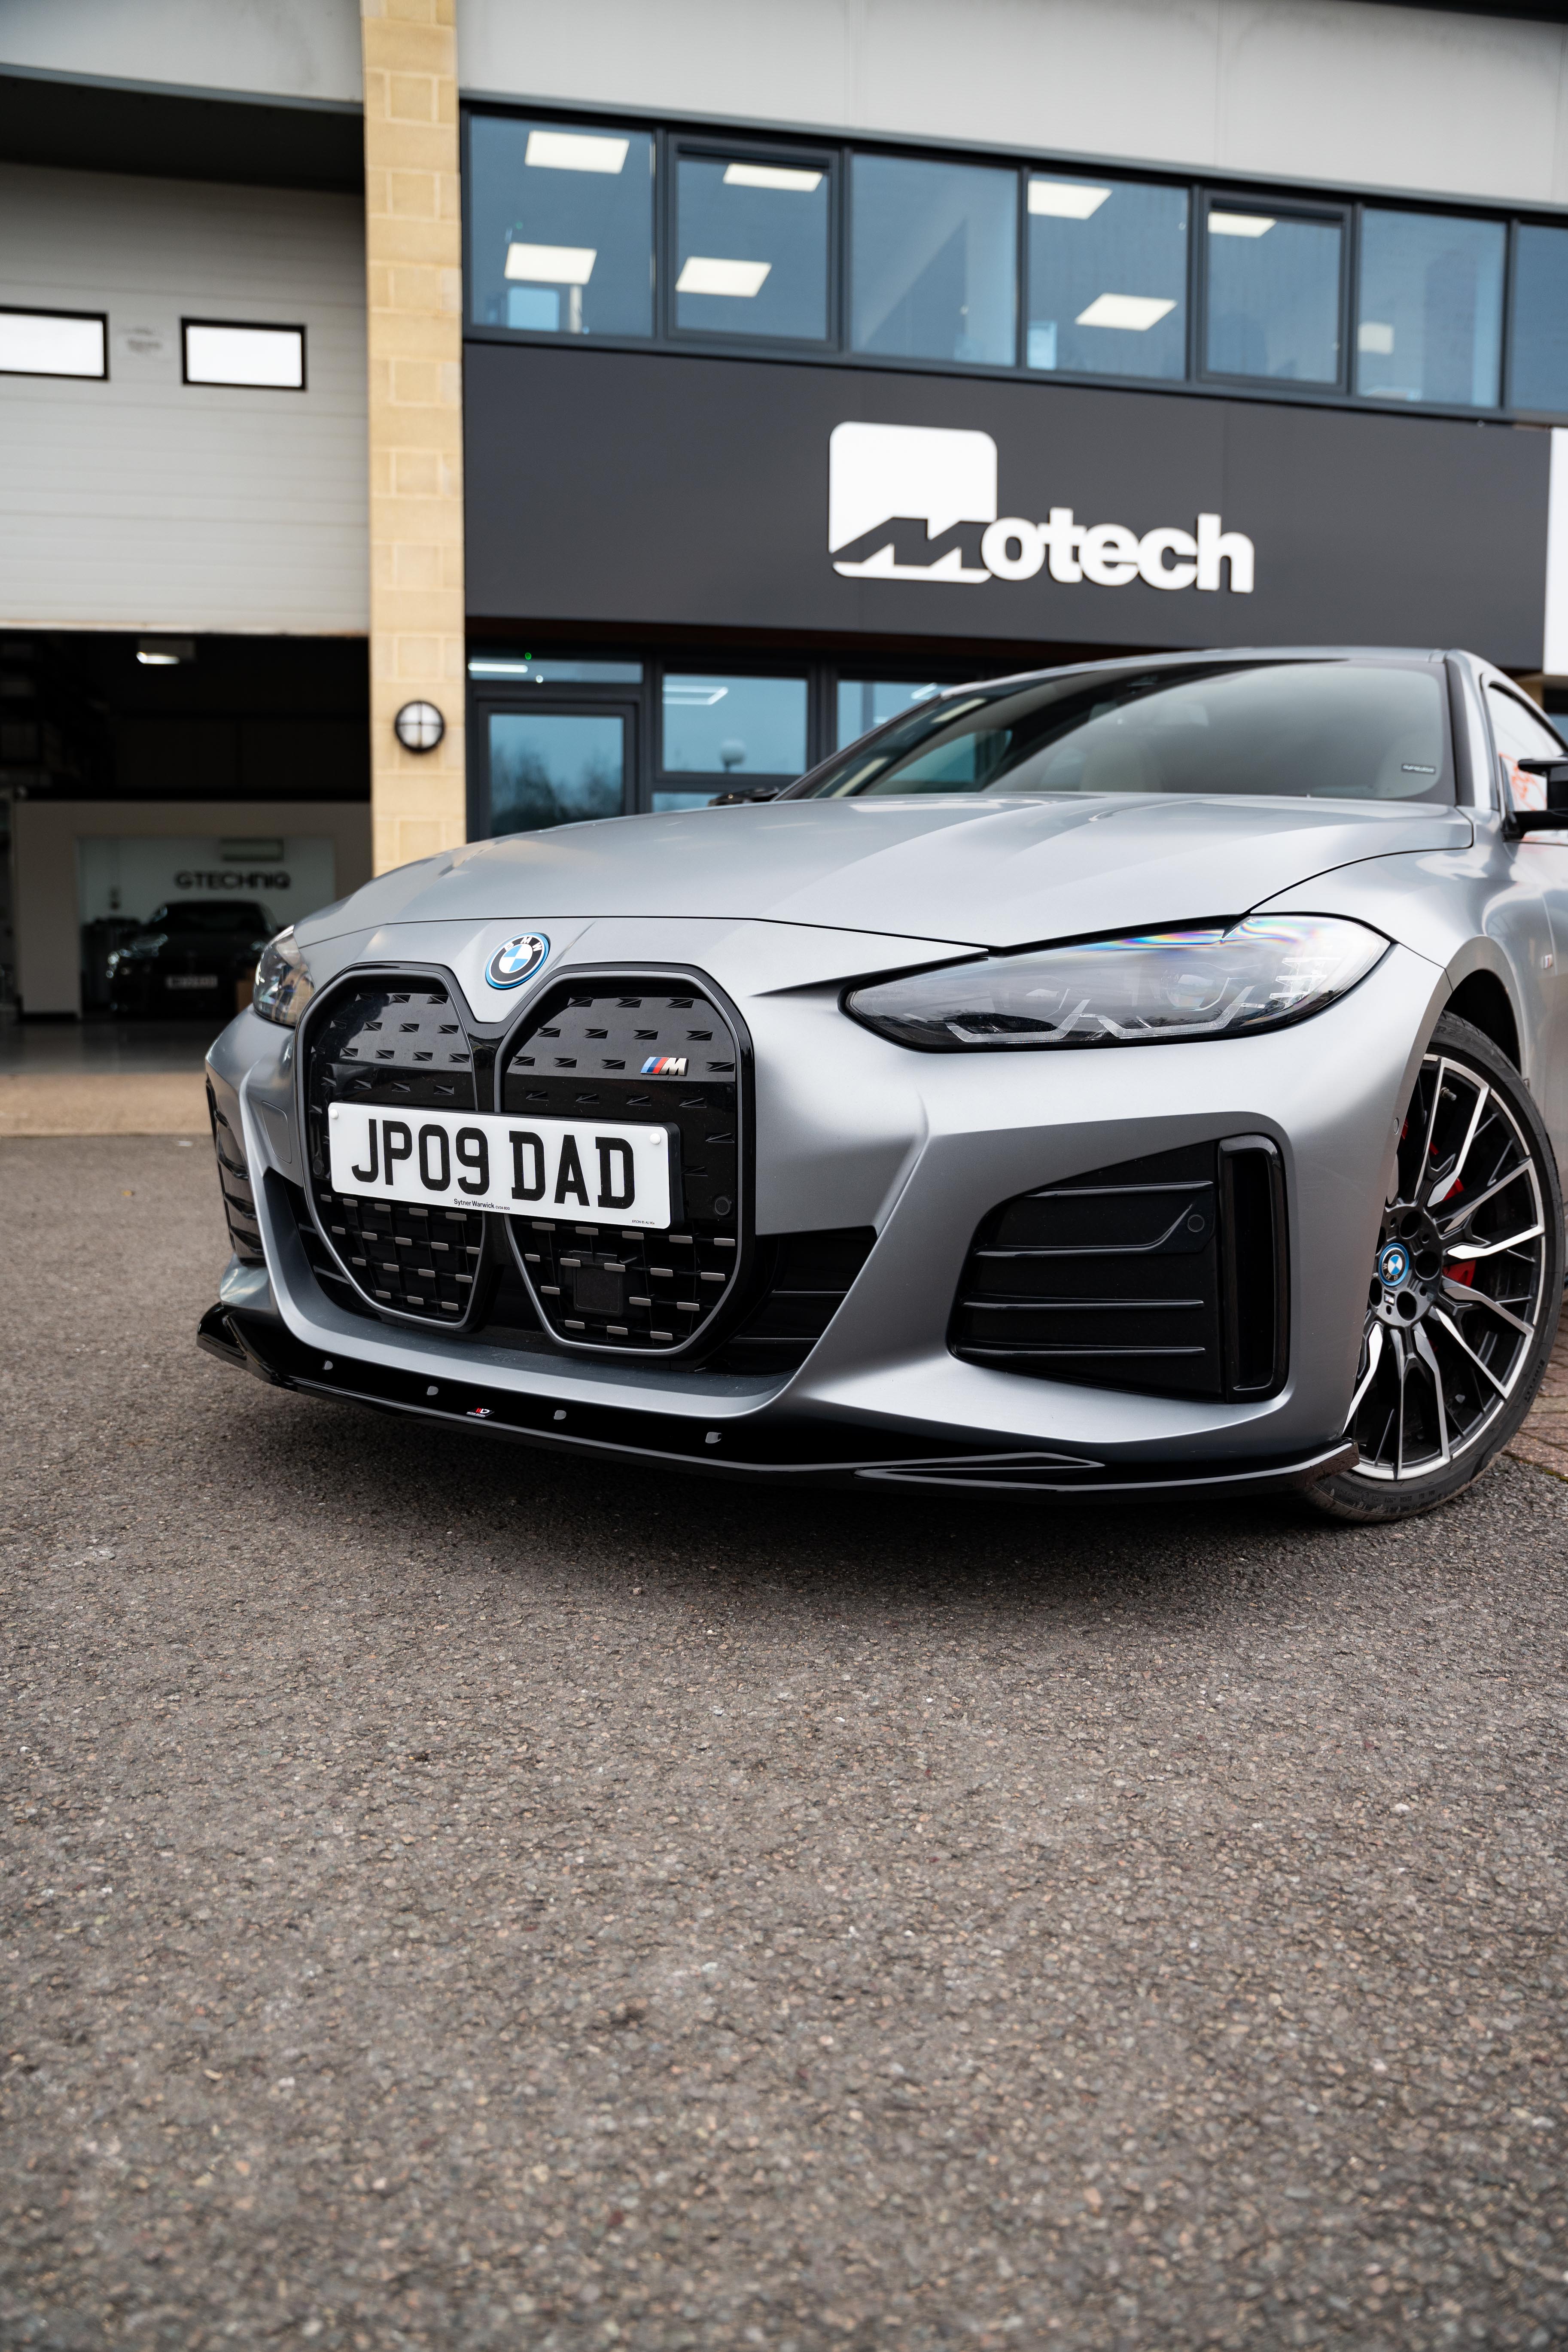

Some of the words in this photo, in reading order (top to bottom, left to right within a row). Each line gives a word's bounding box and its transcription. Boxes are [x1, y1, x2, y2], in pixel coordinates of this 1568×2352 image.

[830, 507, 1254, 593] Motech
[174, 870, 292, 890] GTECHNIQ
[504, 936, 542, 952] BMW
[351, 1118, 490, 1196] JP09
[509, 1130, 636, 1210] DAD
[472, 1200, 495, 1209] Warwick
[1382, 1263, 1398, 1281] BMW
